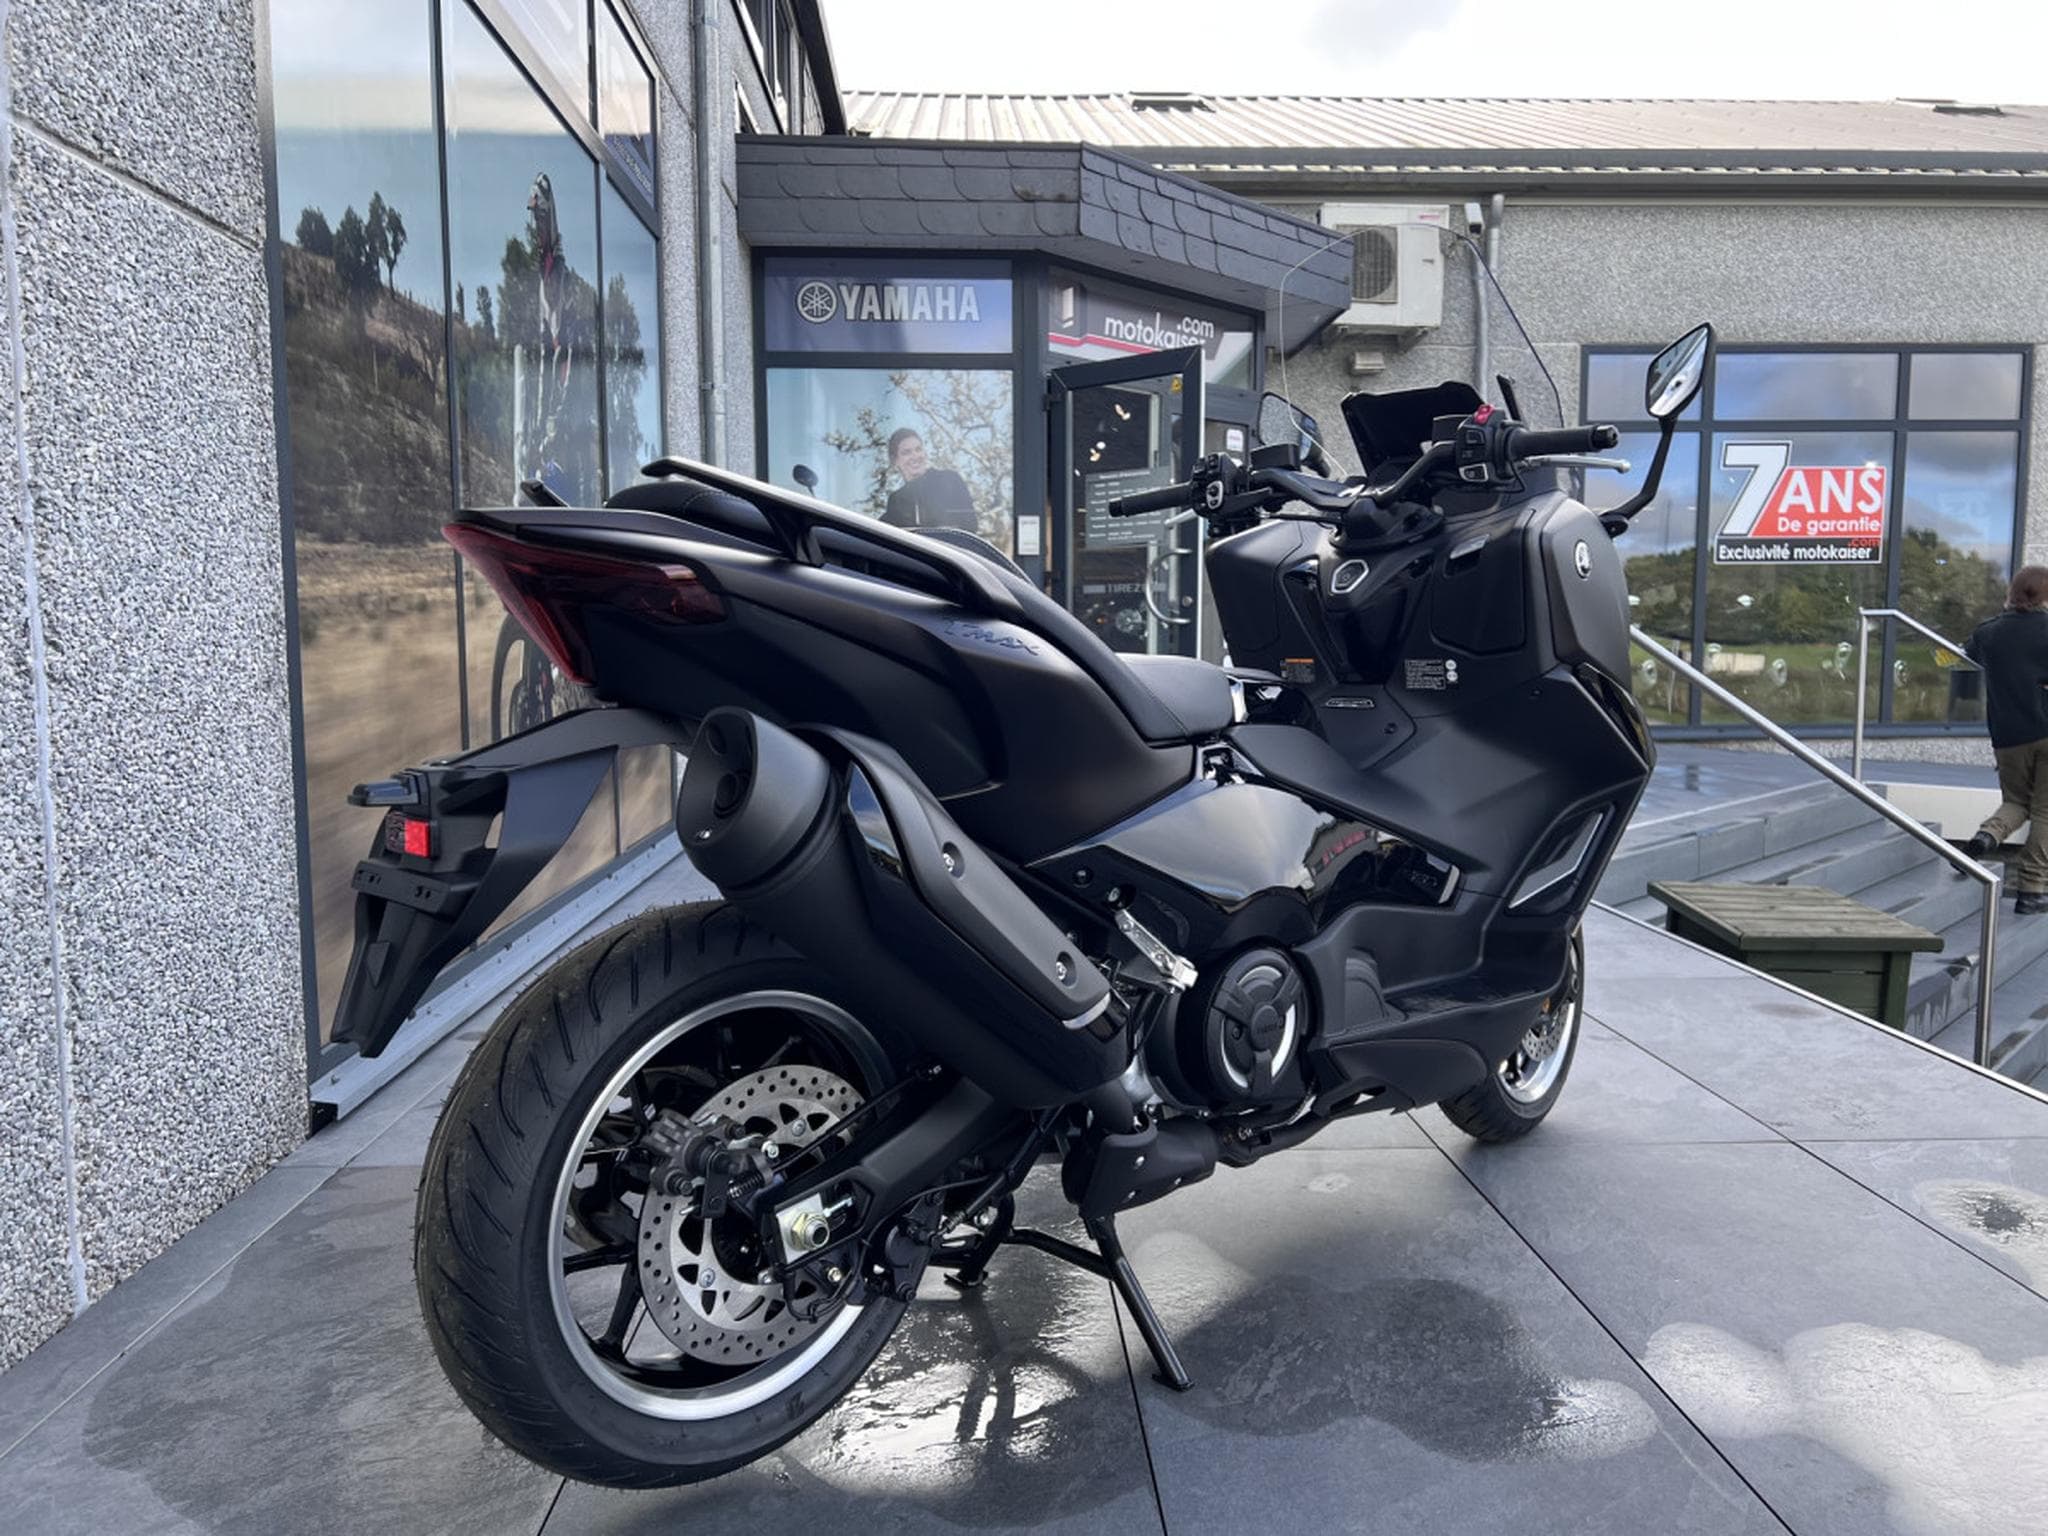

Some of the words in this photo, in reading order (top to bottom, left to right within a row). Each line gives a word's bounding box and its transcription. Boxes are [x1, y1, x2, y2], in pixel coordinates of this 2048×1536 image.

[838, 284, 981, 321] YAMAHA
[1104, 312, 1206, 349] motokaise
[1177, 316, 1214, 338] .com
[1721, 443, 1789, 536] 7
[1778, 470, 1882, 514] ANS
[1777, 516, 1801, 532] De
[1807, 516, 1881, 535] garantie
[1719, 542, 1791, 560] Exclusivité
[1793, 544, 1872, 560] motokaiser
